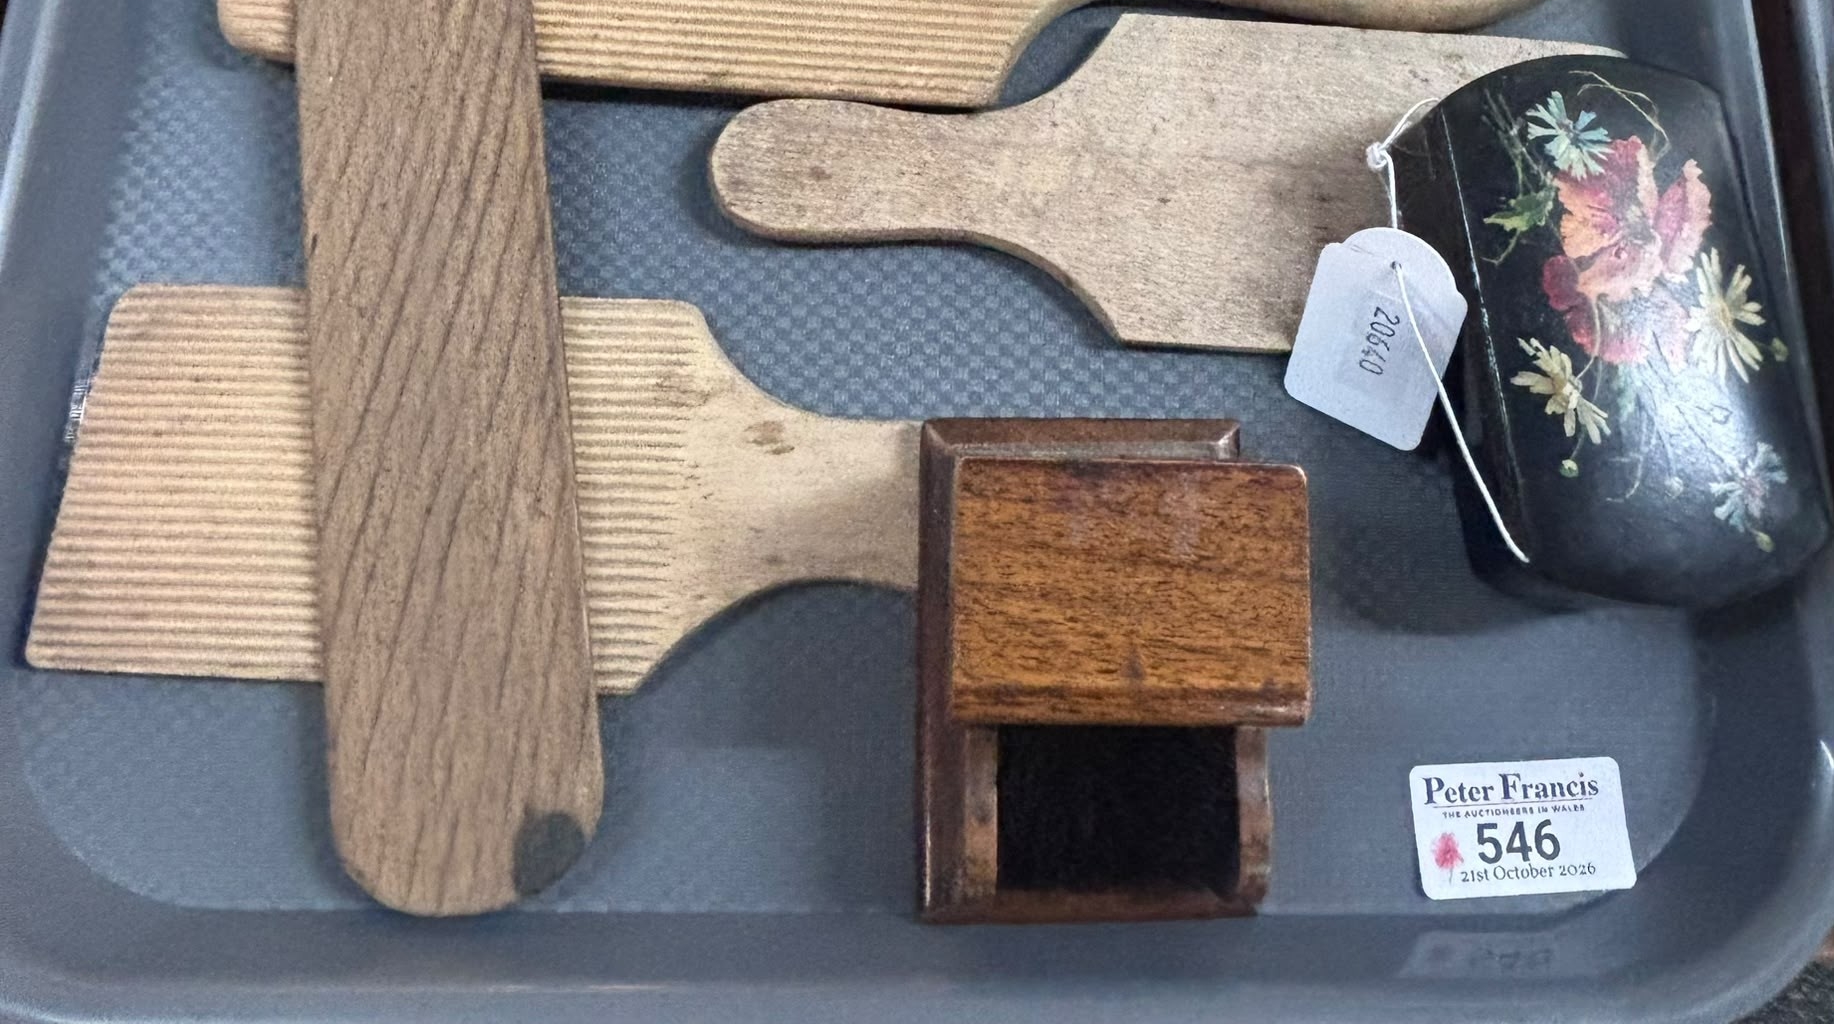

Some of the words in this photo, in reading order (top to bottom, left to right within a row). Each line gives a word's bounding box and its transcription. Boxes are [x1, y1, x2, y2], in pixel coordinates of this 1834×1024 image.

[1359, 306, 1400, 376] 20640
[1421, 776, 1494, 806] Peter
[1498, 772, 1600, 802] Francis
[1442, 810, 1461, 819] THE
[1464, 806, 1534, 819] AUCTIONEERS
[1537, 805, 1549, 815] IN
[1551, 803, 1585, 813] WALES
[1476, 819, 1561, 864] 546
[1460, 868, 1489, 883] 21st
[1493, 863, 1554, 881] October
[1558, 861, 1596, 877] 2026
